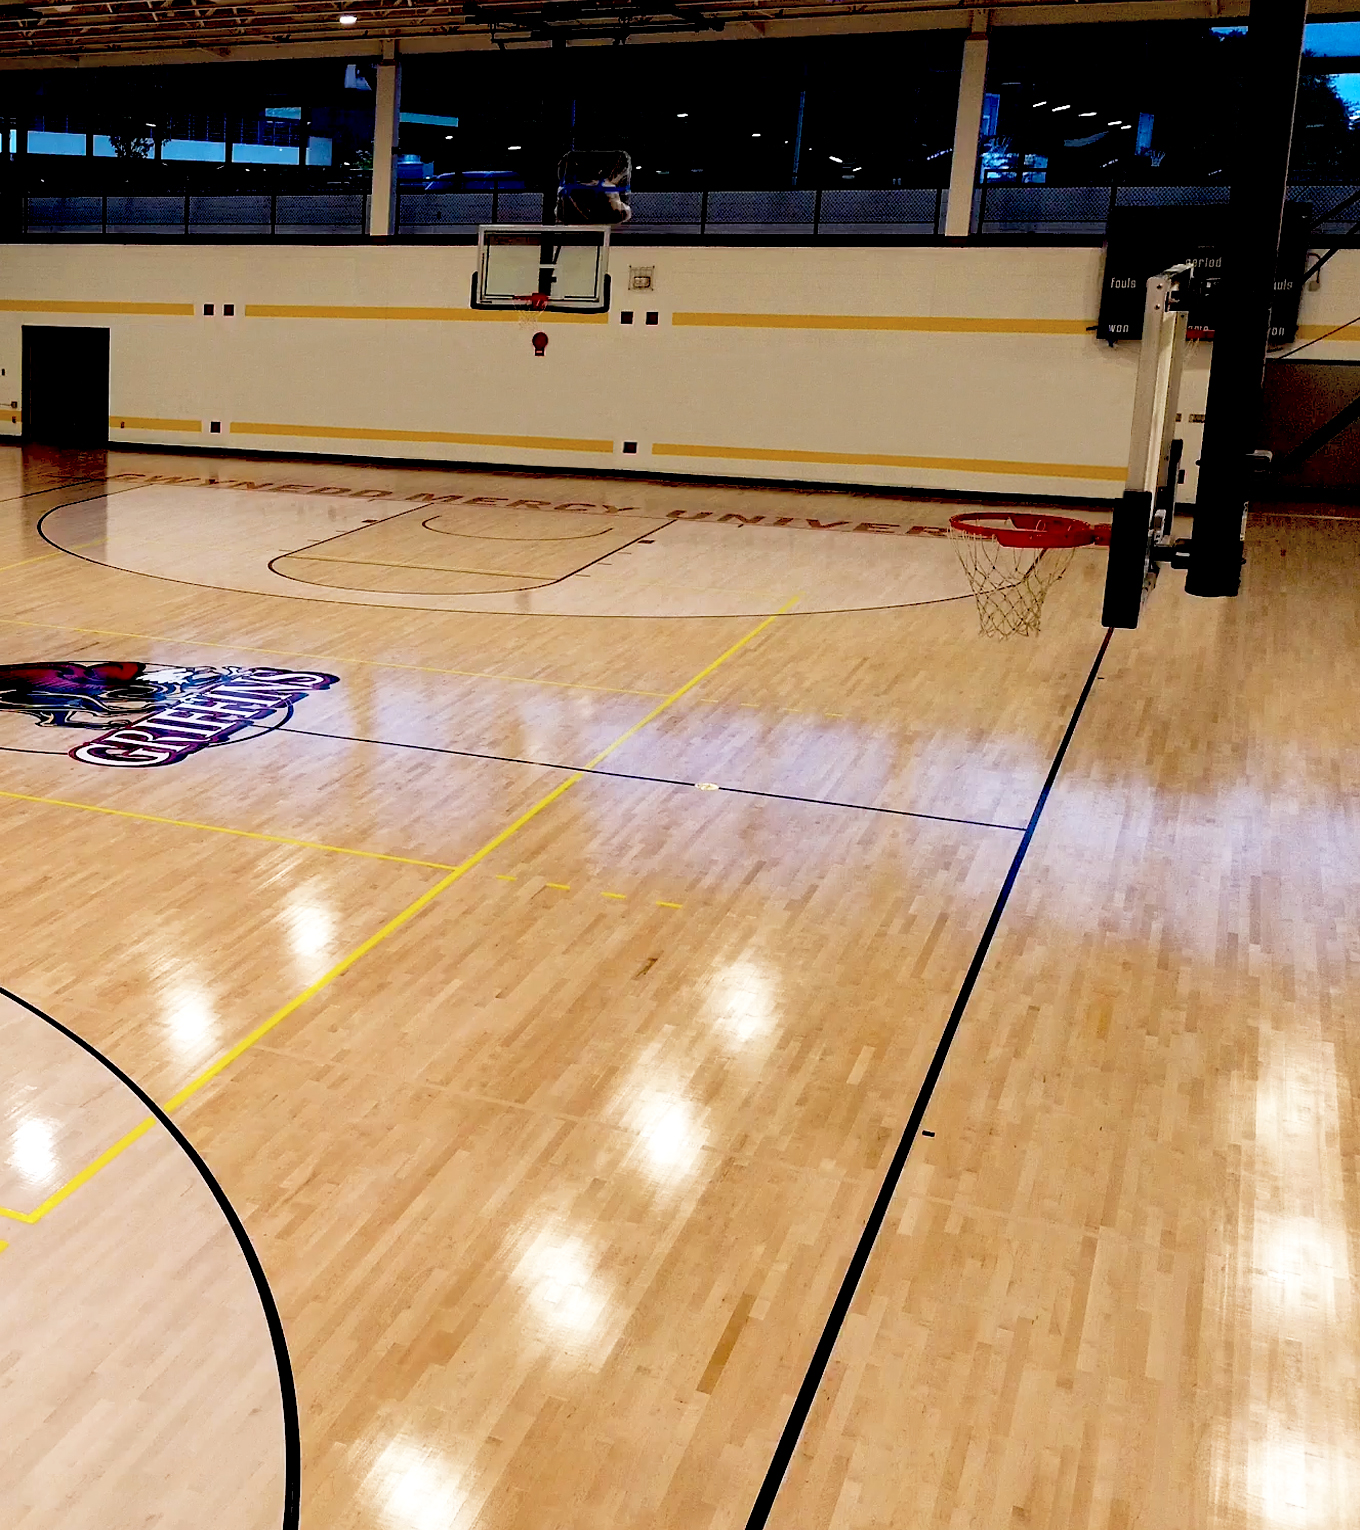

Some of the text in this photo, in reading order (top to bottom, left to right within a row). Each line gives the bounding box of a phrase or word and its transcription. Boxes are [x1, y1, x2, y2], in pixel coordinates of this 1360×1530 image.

[1110, 277, 1136, 288] fouls
[1108, 324, 1129, 333] won
[405, 492, 640, 514] MERCY
[666, 509, 951, 537] UNIVER
[68, 667, 340, 767] GRIFFINS
